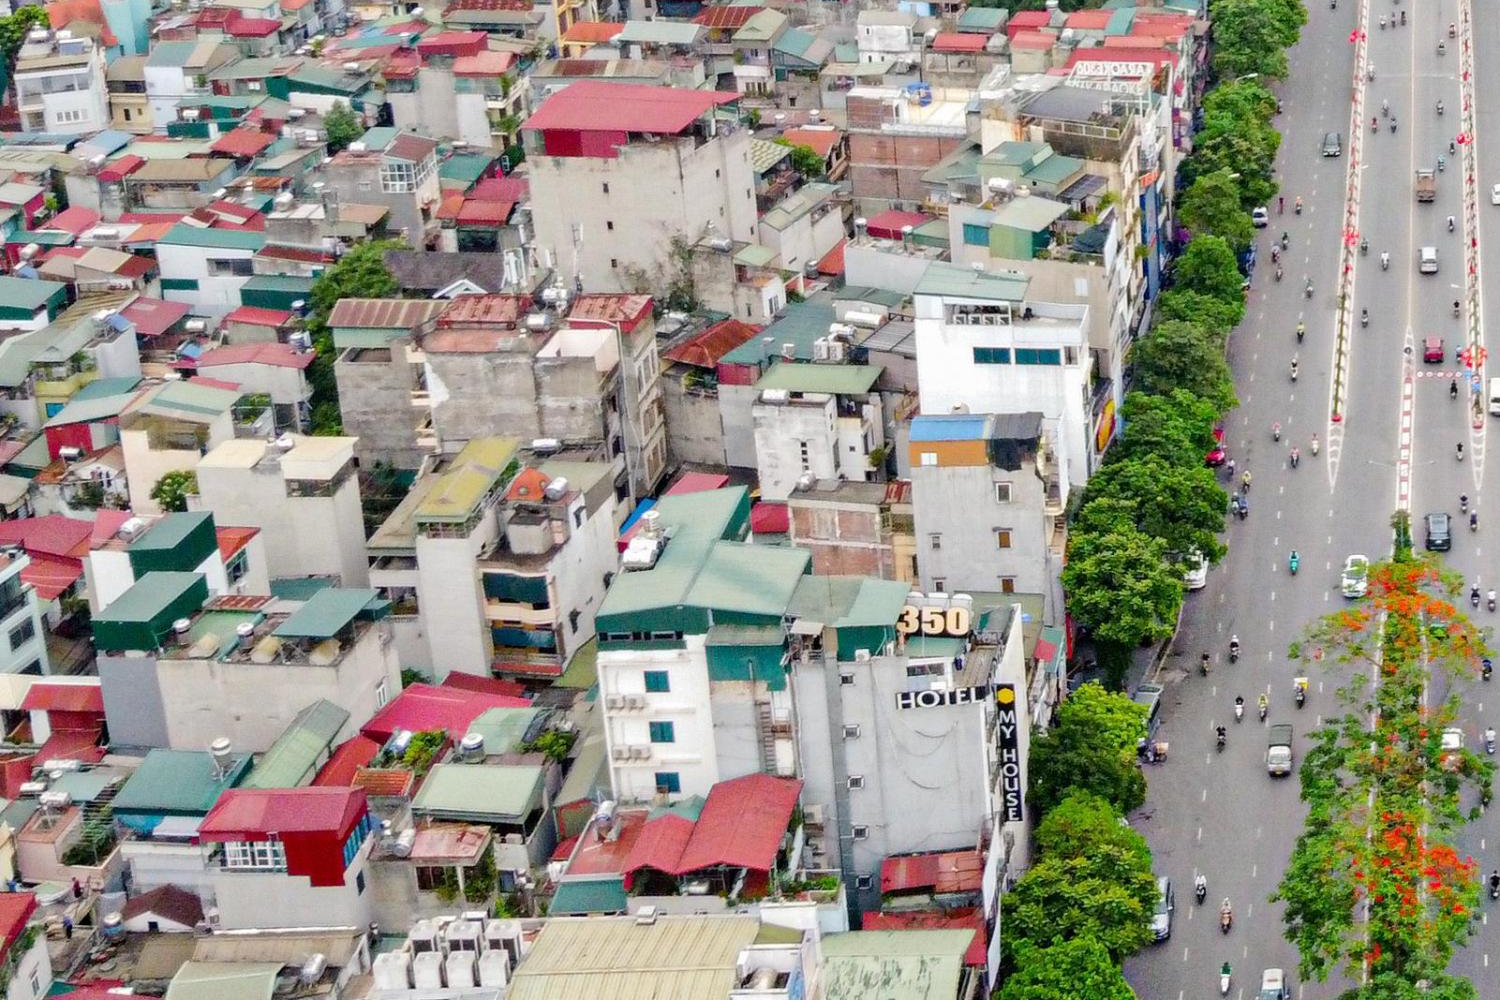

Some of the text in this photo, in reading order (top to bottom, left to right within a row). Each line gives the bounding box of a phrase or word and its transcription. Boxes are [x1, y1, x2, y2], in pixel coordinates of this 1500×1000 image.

[897, 606, 969, 636] 350
[897, 686, 983, 710] HOTEL
[999, 710, 1021, 821] MY HOUSE
